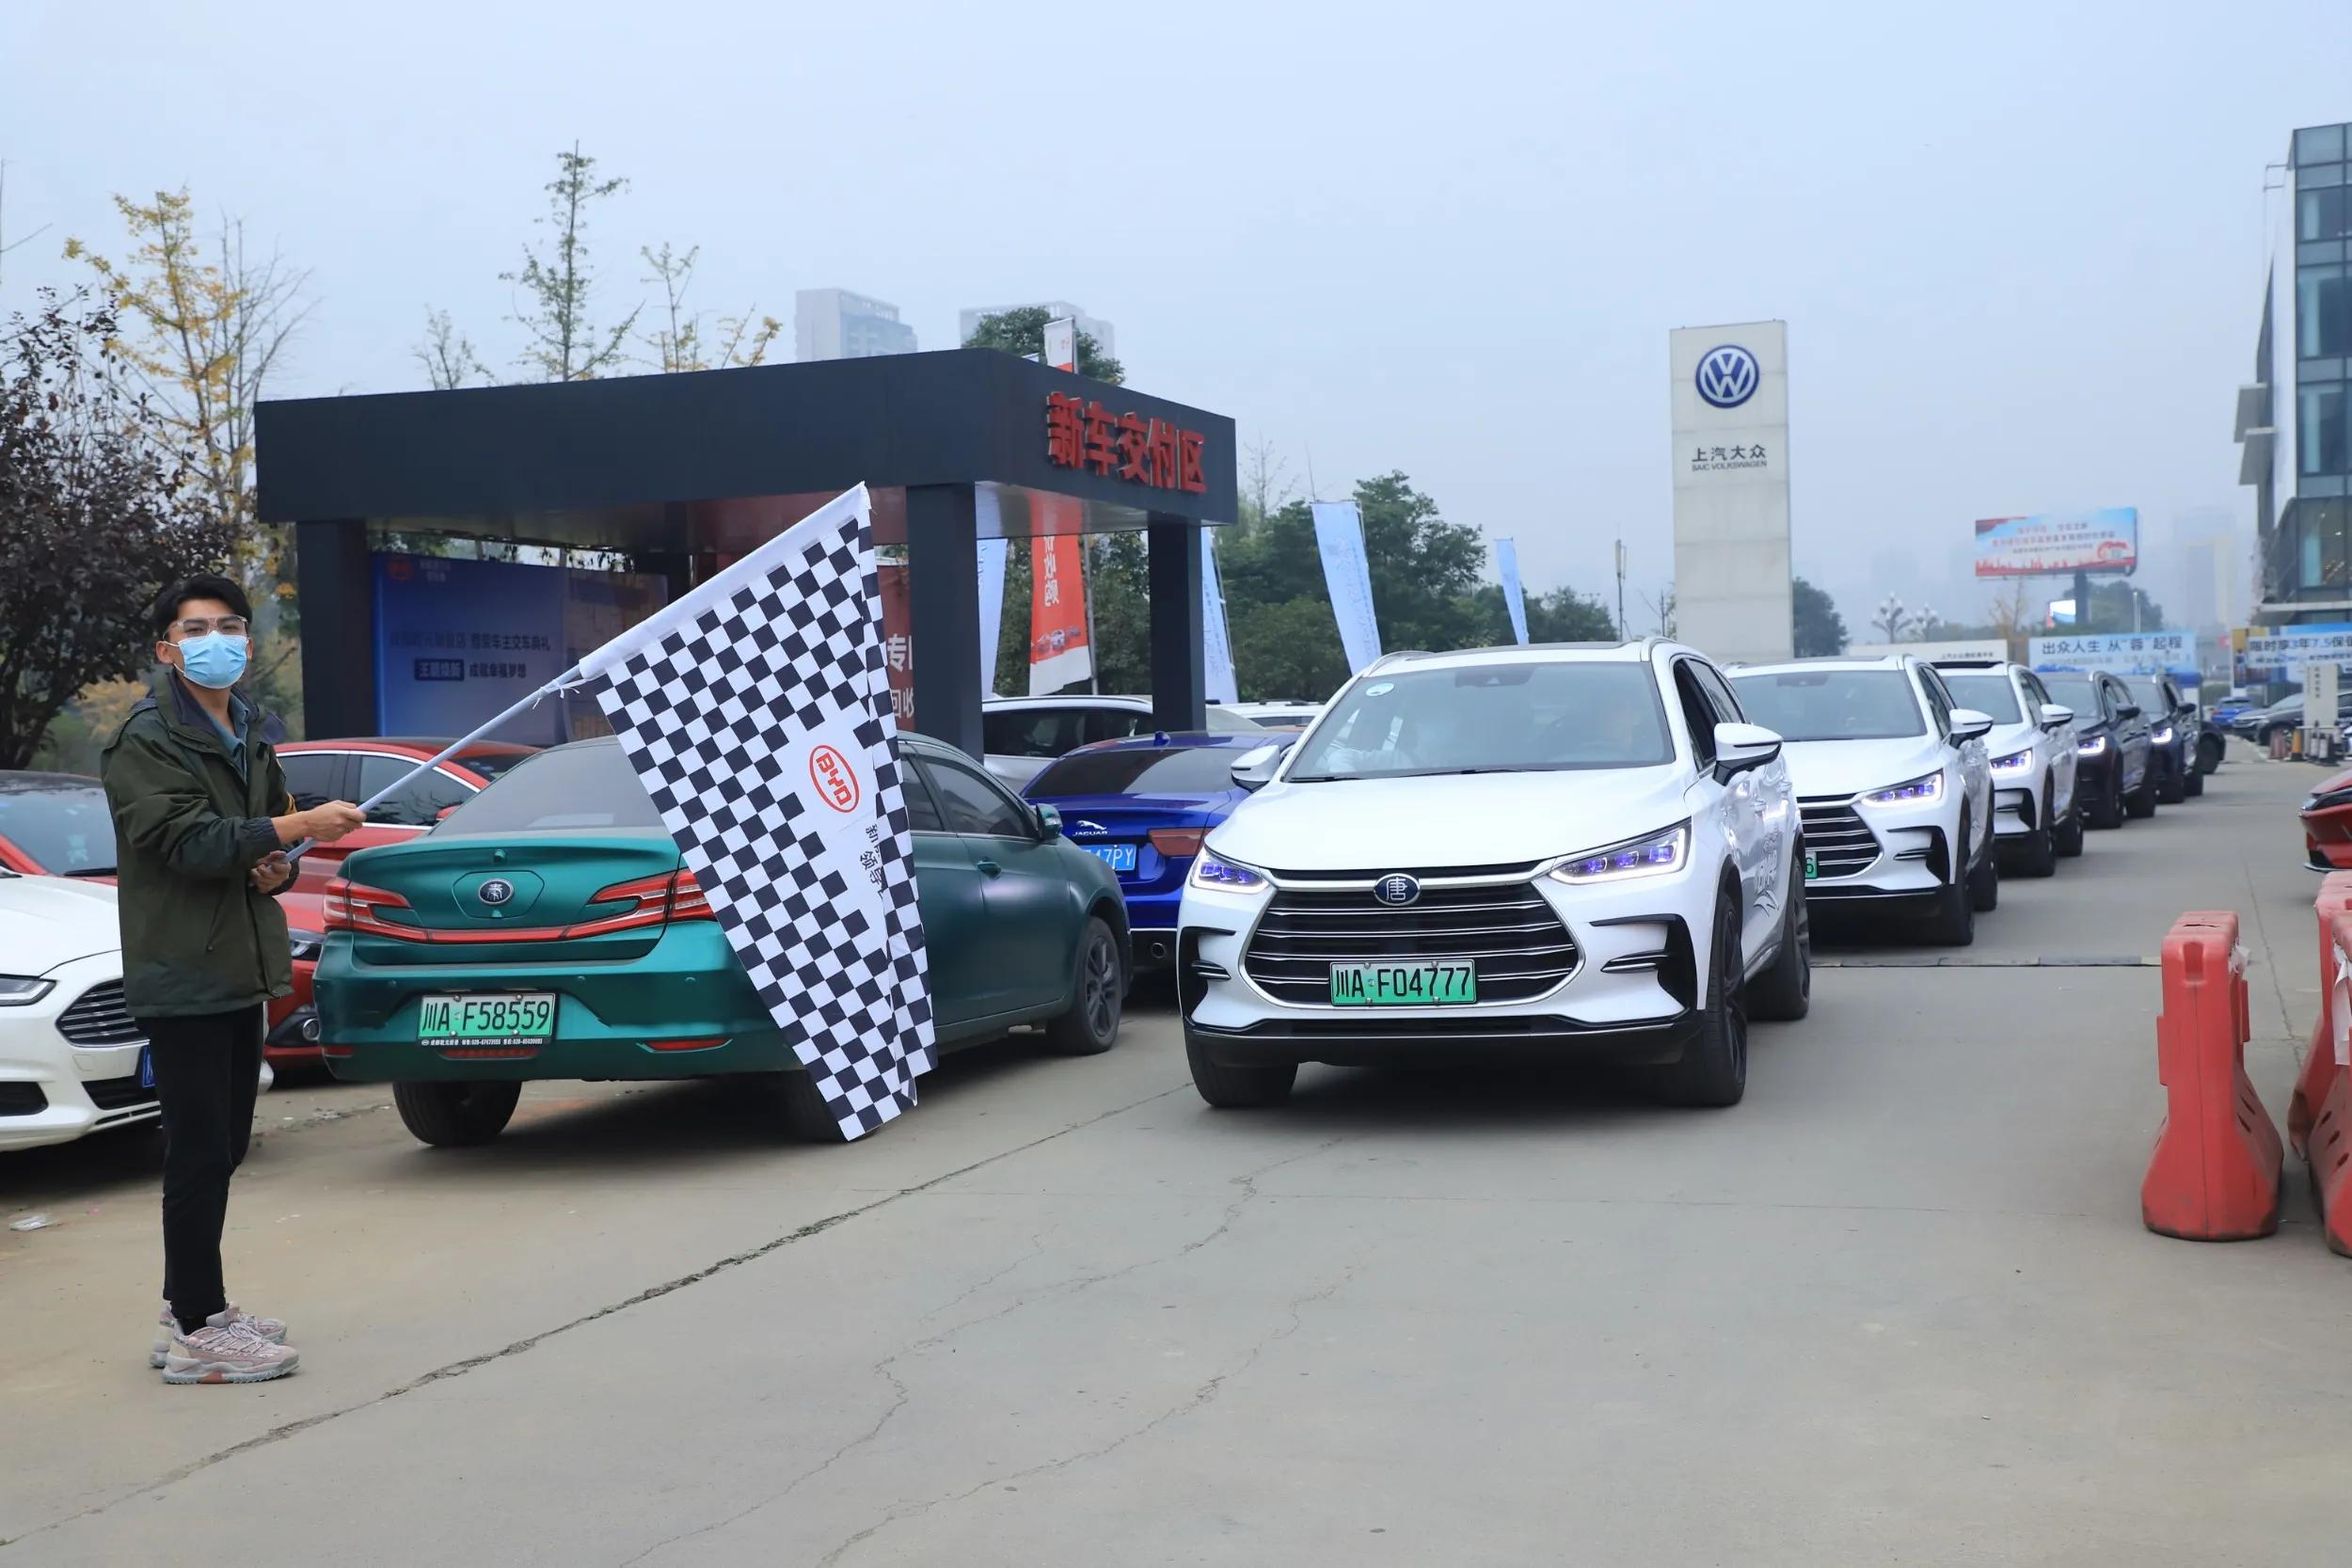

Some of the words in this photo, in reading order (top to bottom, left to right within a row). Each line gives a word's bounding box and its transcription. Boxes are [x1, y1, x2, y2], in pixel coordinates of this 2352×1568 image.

[1046, 390, 1207, 493] 新车交付区
[1692, 443, 1767, 463] 上汽大众
[1712, 459, 1768, 469] VOLKSWAGEN
[887, 632, 914, 673] 专
[2042, 641, 2102, 655] 出众人生
[815, 752, 852, 806] BYD
